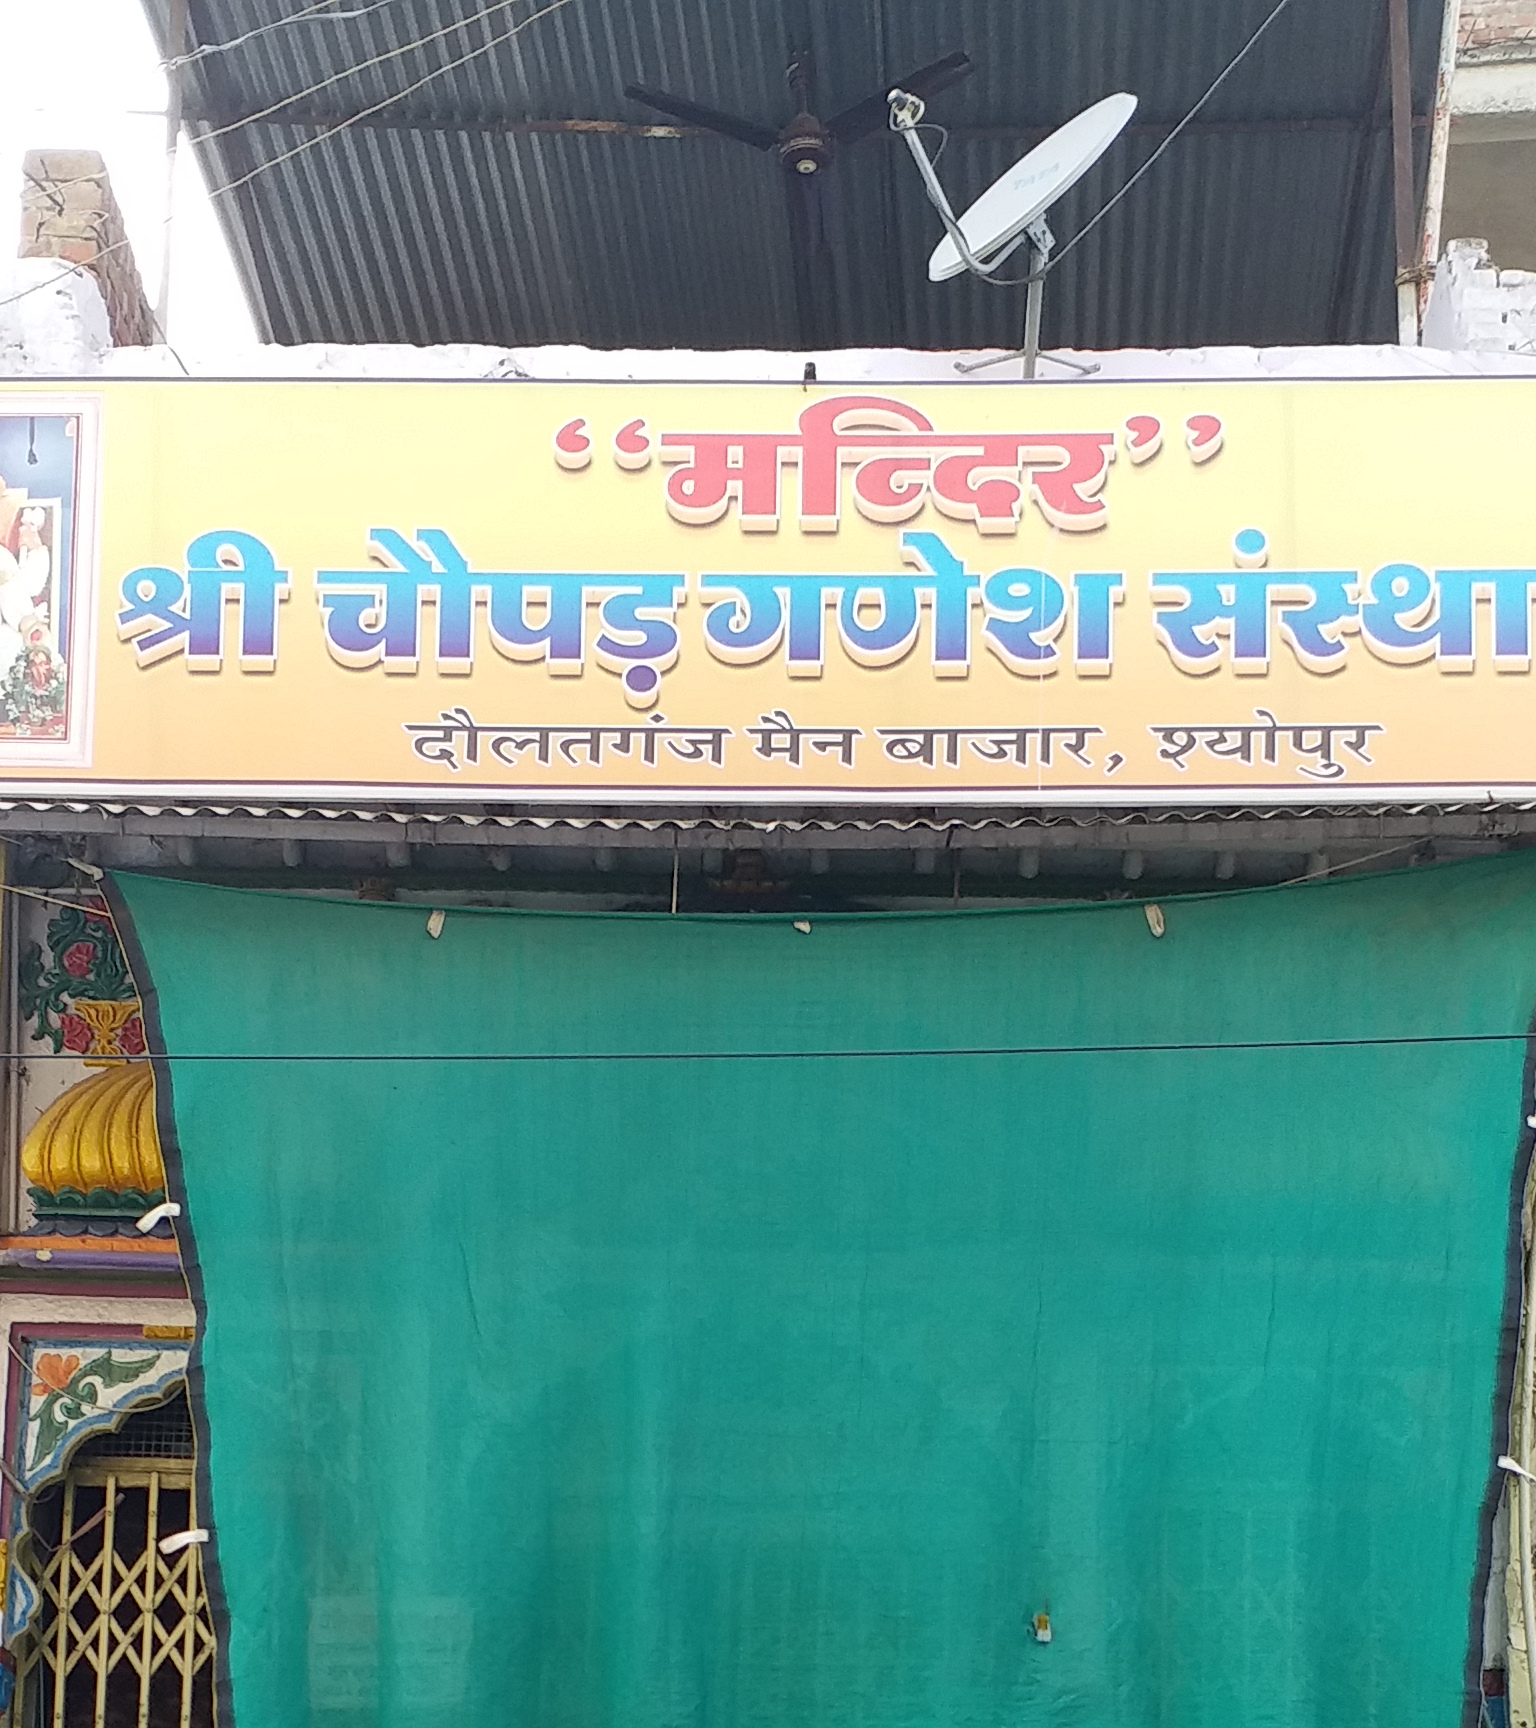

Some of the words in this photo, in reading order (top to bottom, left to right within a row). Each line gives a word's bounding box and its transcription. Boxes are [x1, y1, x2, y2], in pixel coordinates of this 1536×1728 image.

[116, 529, 291, 671] श्री
[316, 528, 688, 707] चौपड़
[699, 533, 1123, 677] गणेश
[403, 709, 731, 771] दौलतगंज
[746, 709, 862, 769] मैन
[876, 722, 1126, 775] बाजार,
[1147, 709, 1383, 778] श्योपुर
